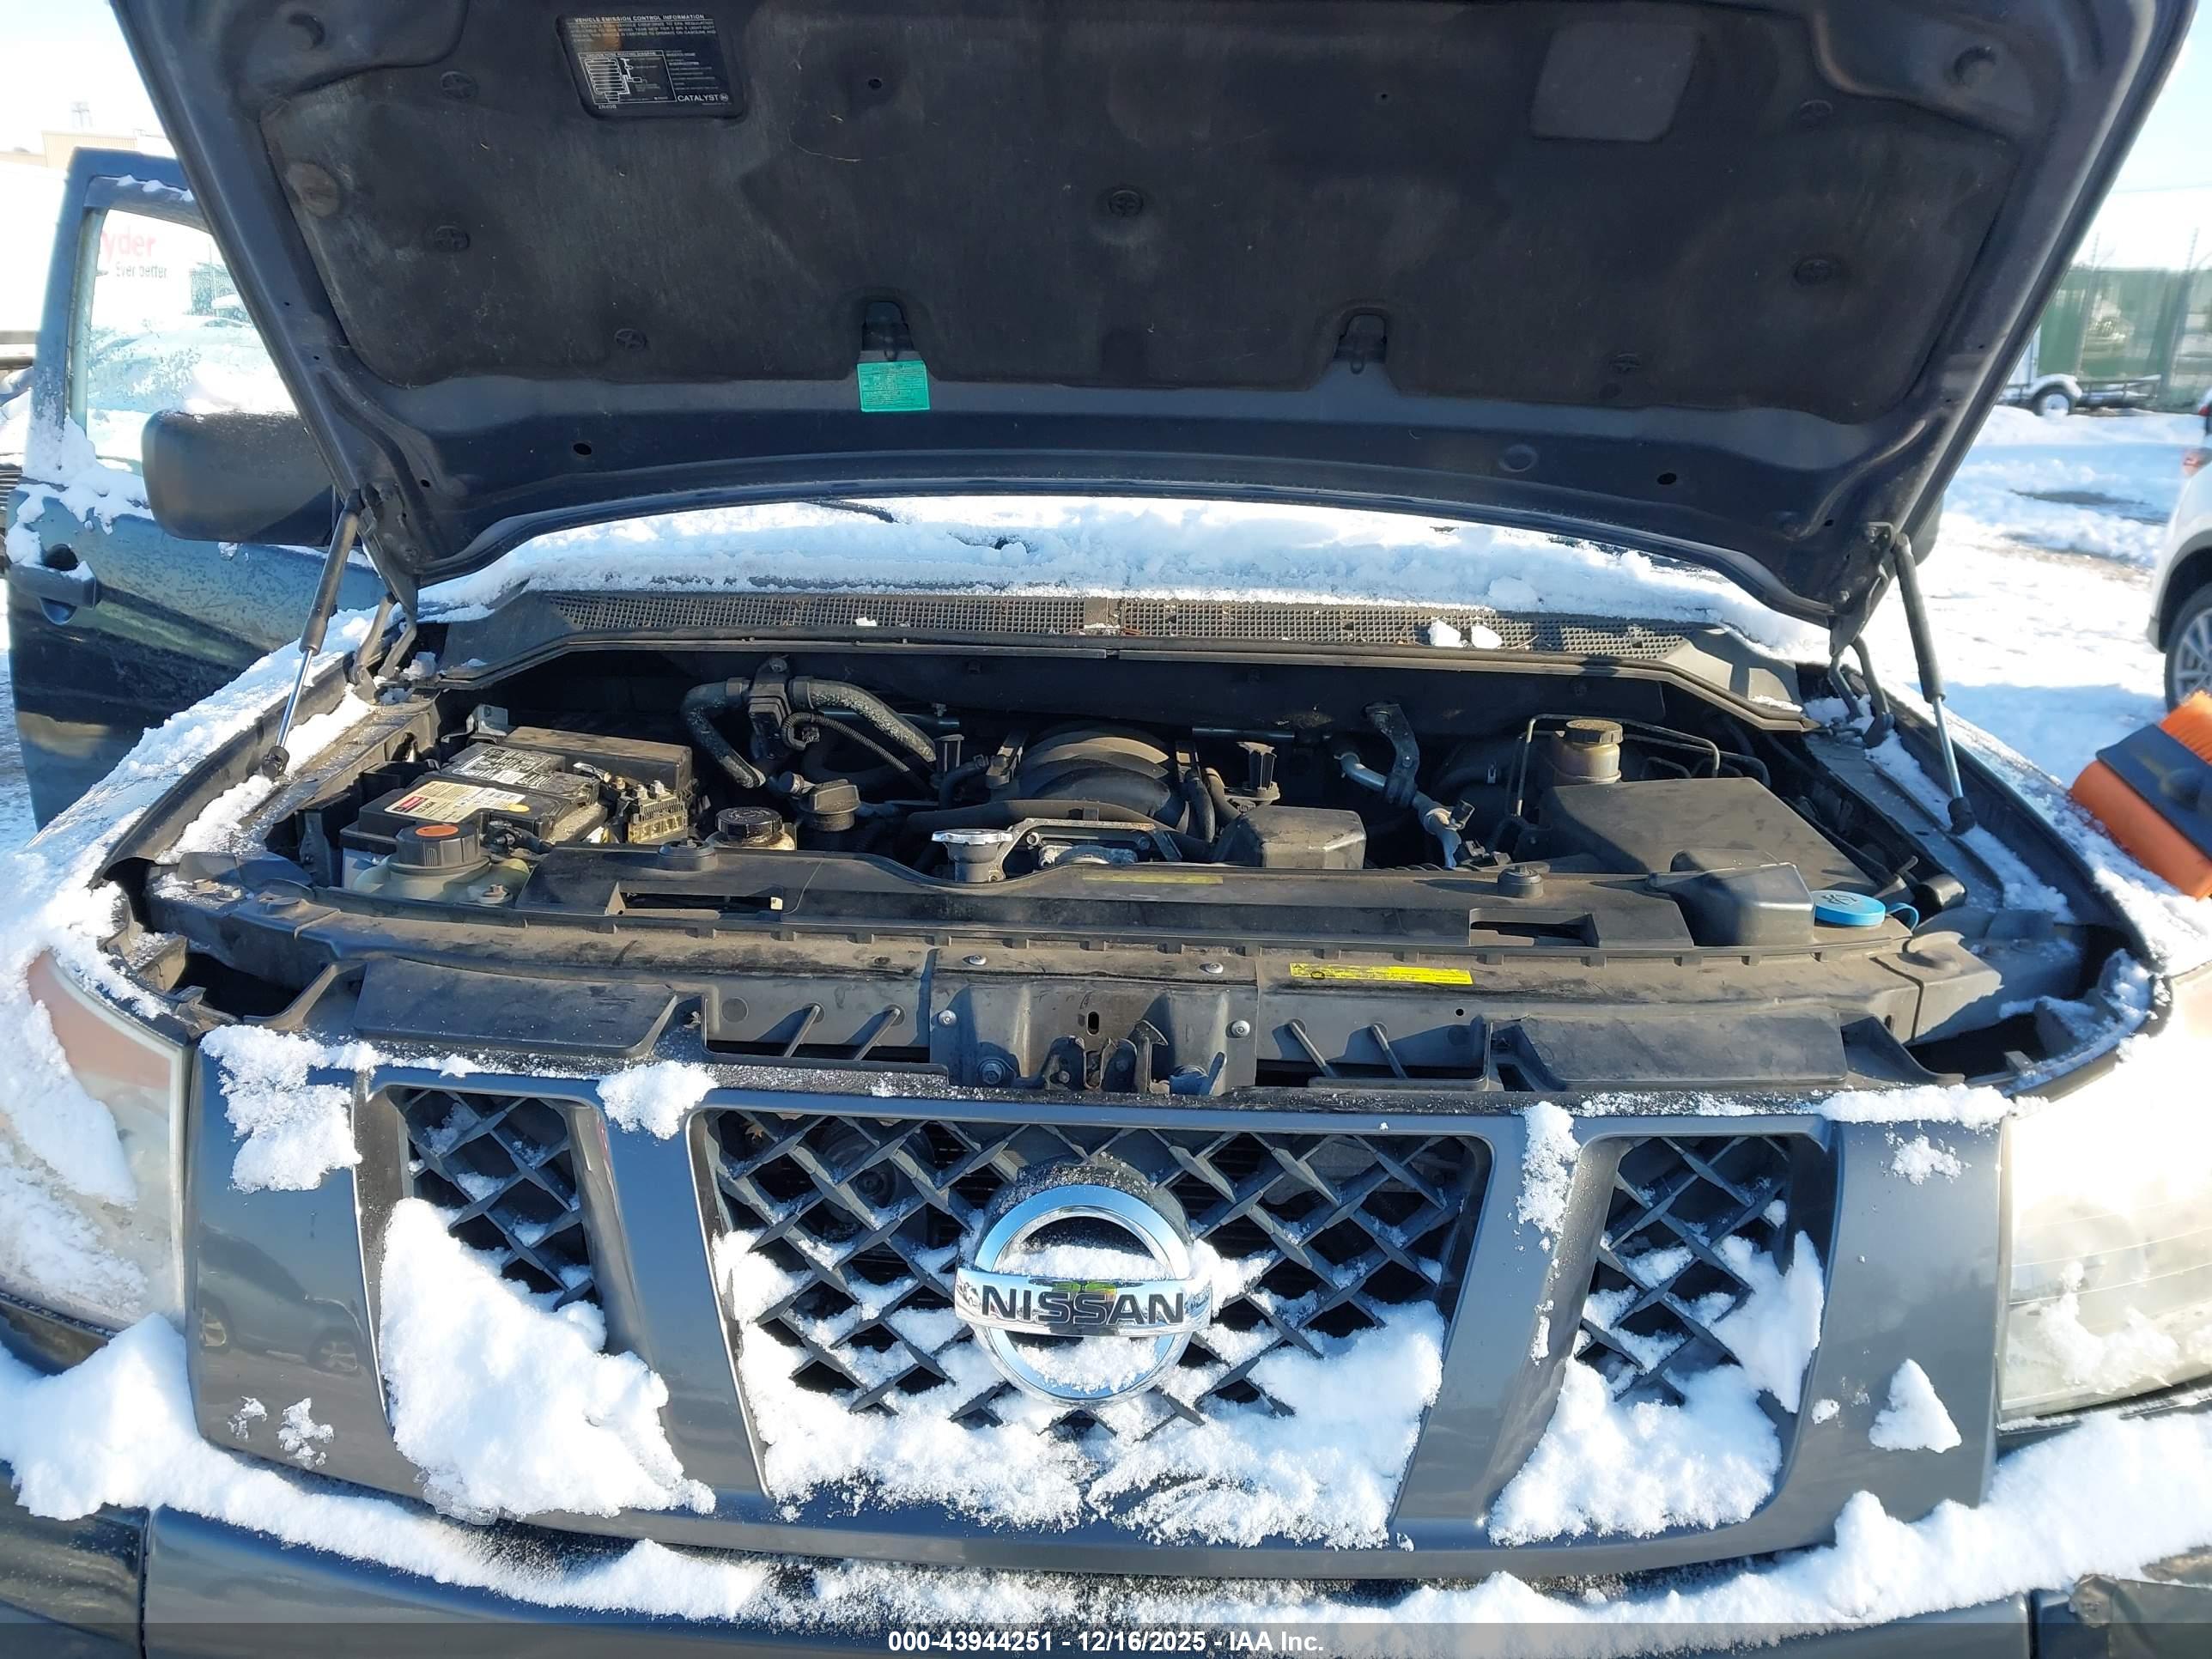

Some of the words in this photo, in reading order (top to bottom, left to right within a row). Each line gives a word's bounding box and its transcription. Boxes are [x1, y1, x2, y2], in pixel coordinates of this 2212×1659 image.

[677, 94, 719, 102] CATALYST
[100, 225, 157, 263] yder
[981, 1284, 1184, 1325] NISSAN
